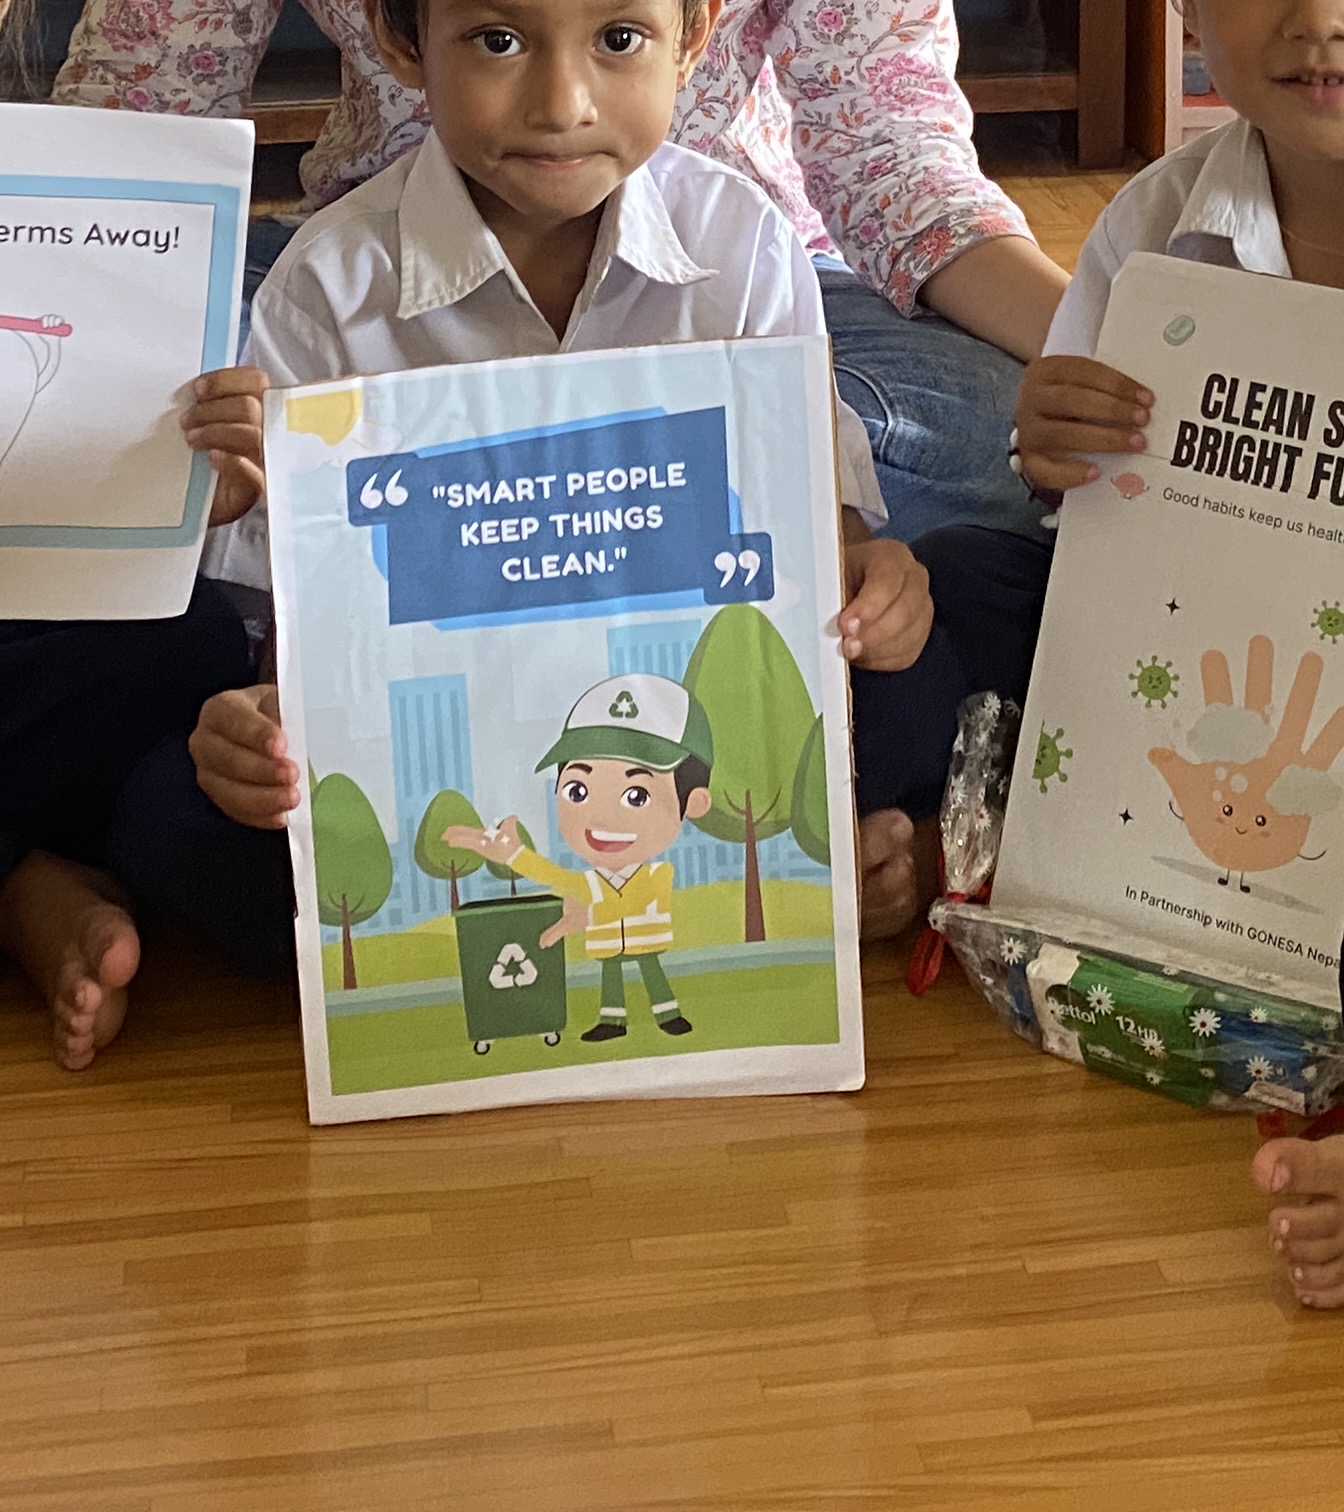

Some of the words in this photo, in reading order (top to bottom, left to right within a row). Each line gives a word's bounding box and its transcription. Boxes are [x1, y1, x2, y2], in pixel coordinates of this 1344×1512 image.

[83, 223, 180, 254] Away!
[1200, 372, 1316, 441] CLEAN
[1169, 420, 1304, 493] BRIGHT
[432, 475, 557, 509] "SMART
[567, 462, 687, 497] PEOPLE
[460, 516, 540, 547] KEEP
[549, 504, 664, 539] THINGS
[1162, 487, 1199, 508] Good
[1203, 497, 1245, 519] habits
[1248, 507, 1284, 530] keep
[1286, 520, 1304, 534] us
[501, 547, 628, 582] CLEAN."
[1125, 885, 1137, 900] In
[1140, 890, 1212, 927] Partnership
[1215, 918, 1244, 937] with
[1247, 926, 1304, 957] GONESA
